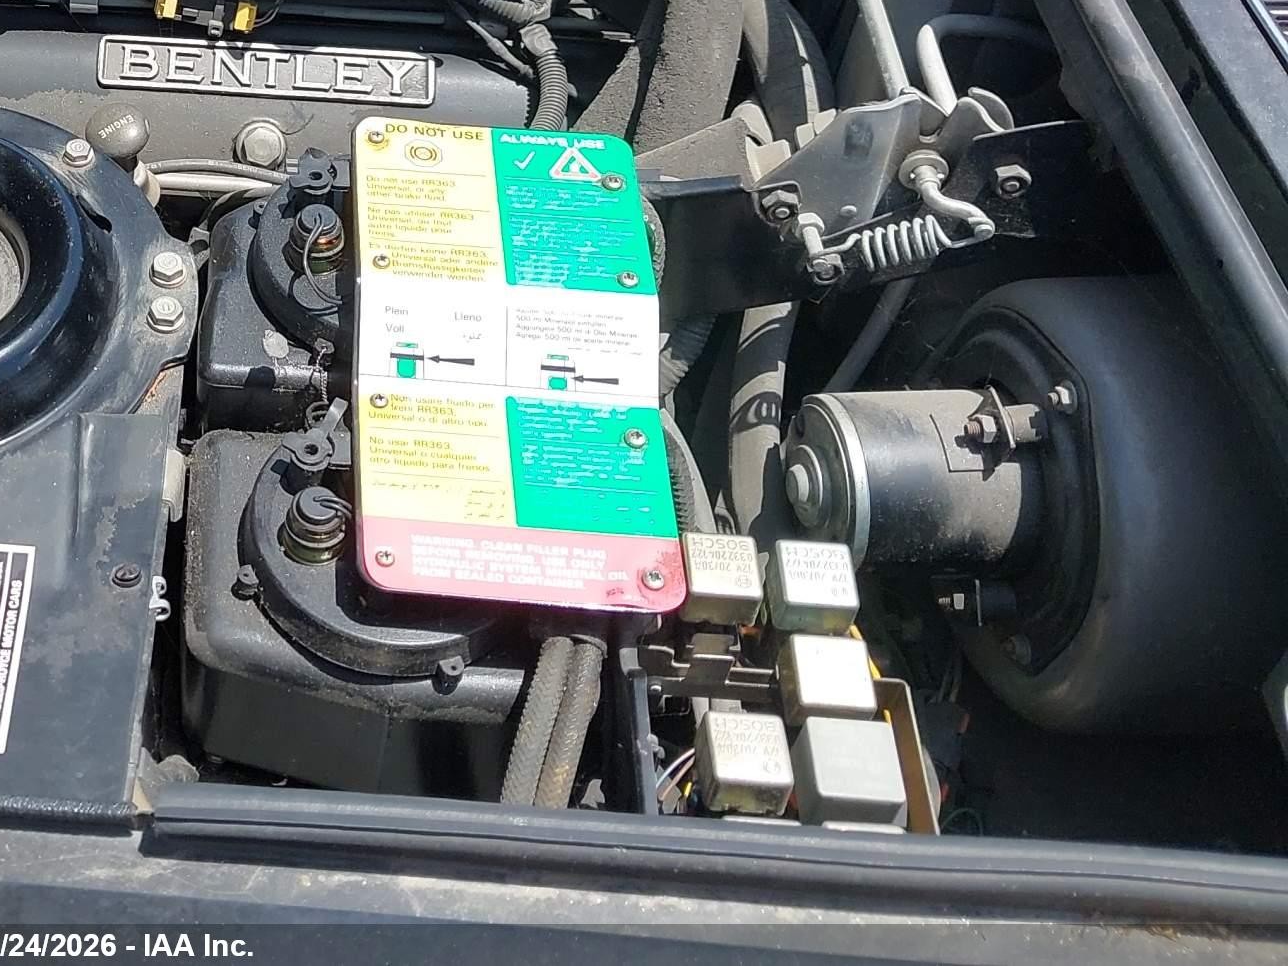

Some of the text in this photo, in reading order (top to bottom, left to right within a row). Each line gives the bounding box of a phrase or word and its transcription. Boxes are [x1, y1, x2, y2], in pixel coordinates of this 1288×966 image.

[119, 43, 420, 97] BENTLEY
[98, 114, 135, 139] ENGINE
[385, 123, 485, 141] DO NOT USE
[499, 134, 606, 149] ALWAYS USE
[384, 305, 410, 315] Plein
[454, 311, 482, 322] Lleno
[385, 323, 404, 333] Voll
[390, 394, 412, 403] Non
[415, 397, 443, 405] usare
[368, 410, 416, 422] Universal
[369, 436, 384, 445] No
[369, 445, 417, 457] Universal
[432, 461, 455, 471] para
[480, 540, 524, 553] CLEAN
[526, 544, 569, 557] FILLER
[572, 547, 608, 561] PLUG
[692, 537, 749, 551] BOSCH
[410, 545, 462, 560] BEFORE
[541, 555, 567, 568] USE
[570, 557, 606, 571] ONLY
[691, 548, 754, 562] 0332204122
[786, 546, 846, 561] BOSCH
[412, 555, 629, 581] HYDRAULIC SYSTEM MINERAL OIL
[412, 565, 452, 579] FROM
[455, 569, 505, 583] SEALED
[735, 563, 753, 575] 12V
[8, 579, 23, 610] CARS
[1, 609, 18, 648] MOTOR
[714, 717, 777, 732] BOSCH
